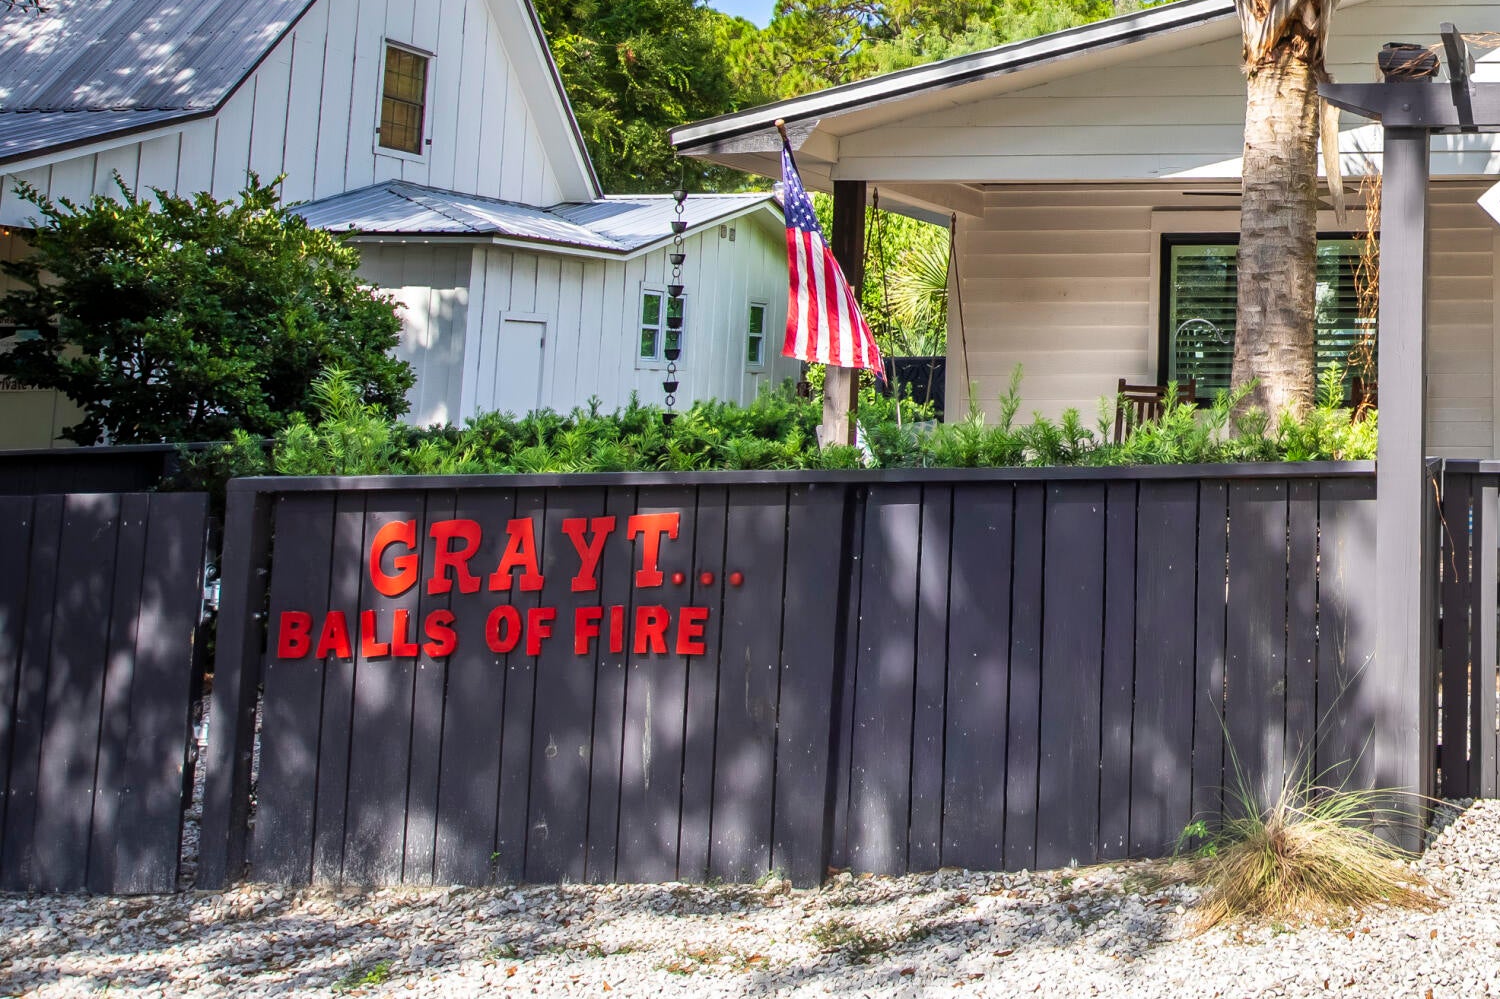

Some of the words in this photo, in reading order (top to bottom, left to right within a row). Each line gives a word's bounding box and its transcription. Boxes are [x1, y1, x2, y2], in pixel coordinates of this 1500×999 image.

[368, 513, 744, 597] GRAYT...
[276, 608, 458, 660] BALLS
[484, 604, 558, 657] OF
[573, 604, 709, 656] FIRE
